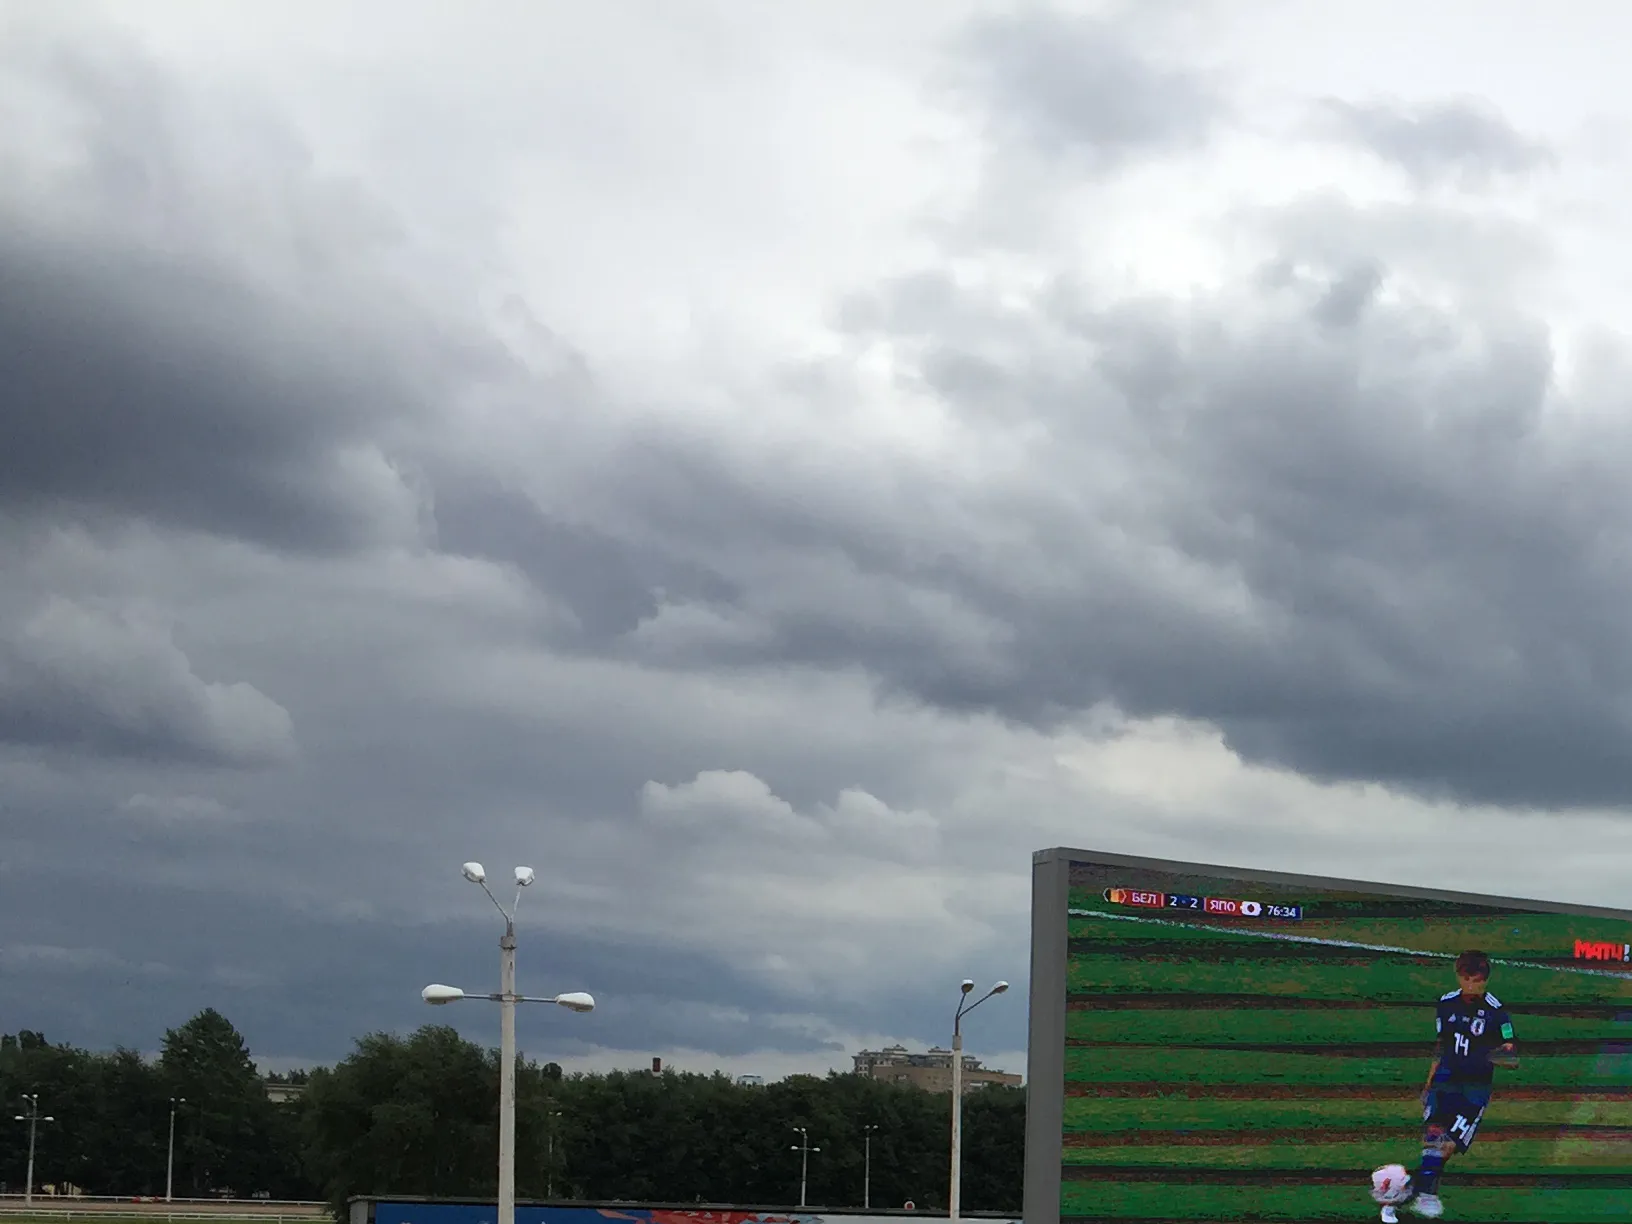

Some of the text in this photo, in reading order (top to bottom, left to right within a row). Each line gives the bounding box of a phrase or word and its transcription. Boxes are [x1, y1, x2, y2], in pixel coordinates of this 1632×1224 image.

[1131, 892, 1297, 917] БЕЛ 2 2 ЯПО 76:34
[1453, 1032, 1470, 1056] 14
[1450, 1114, 1470, 1139] 14
